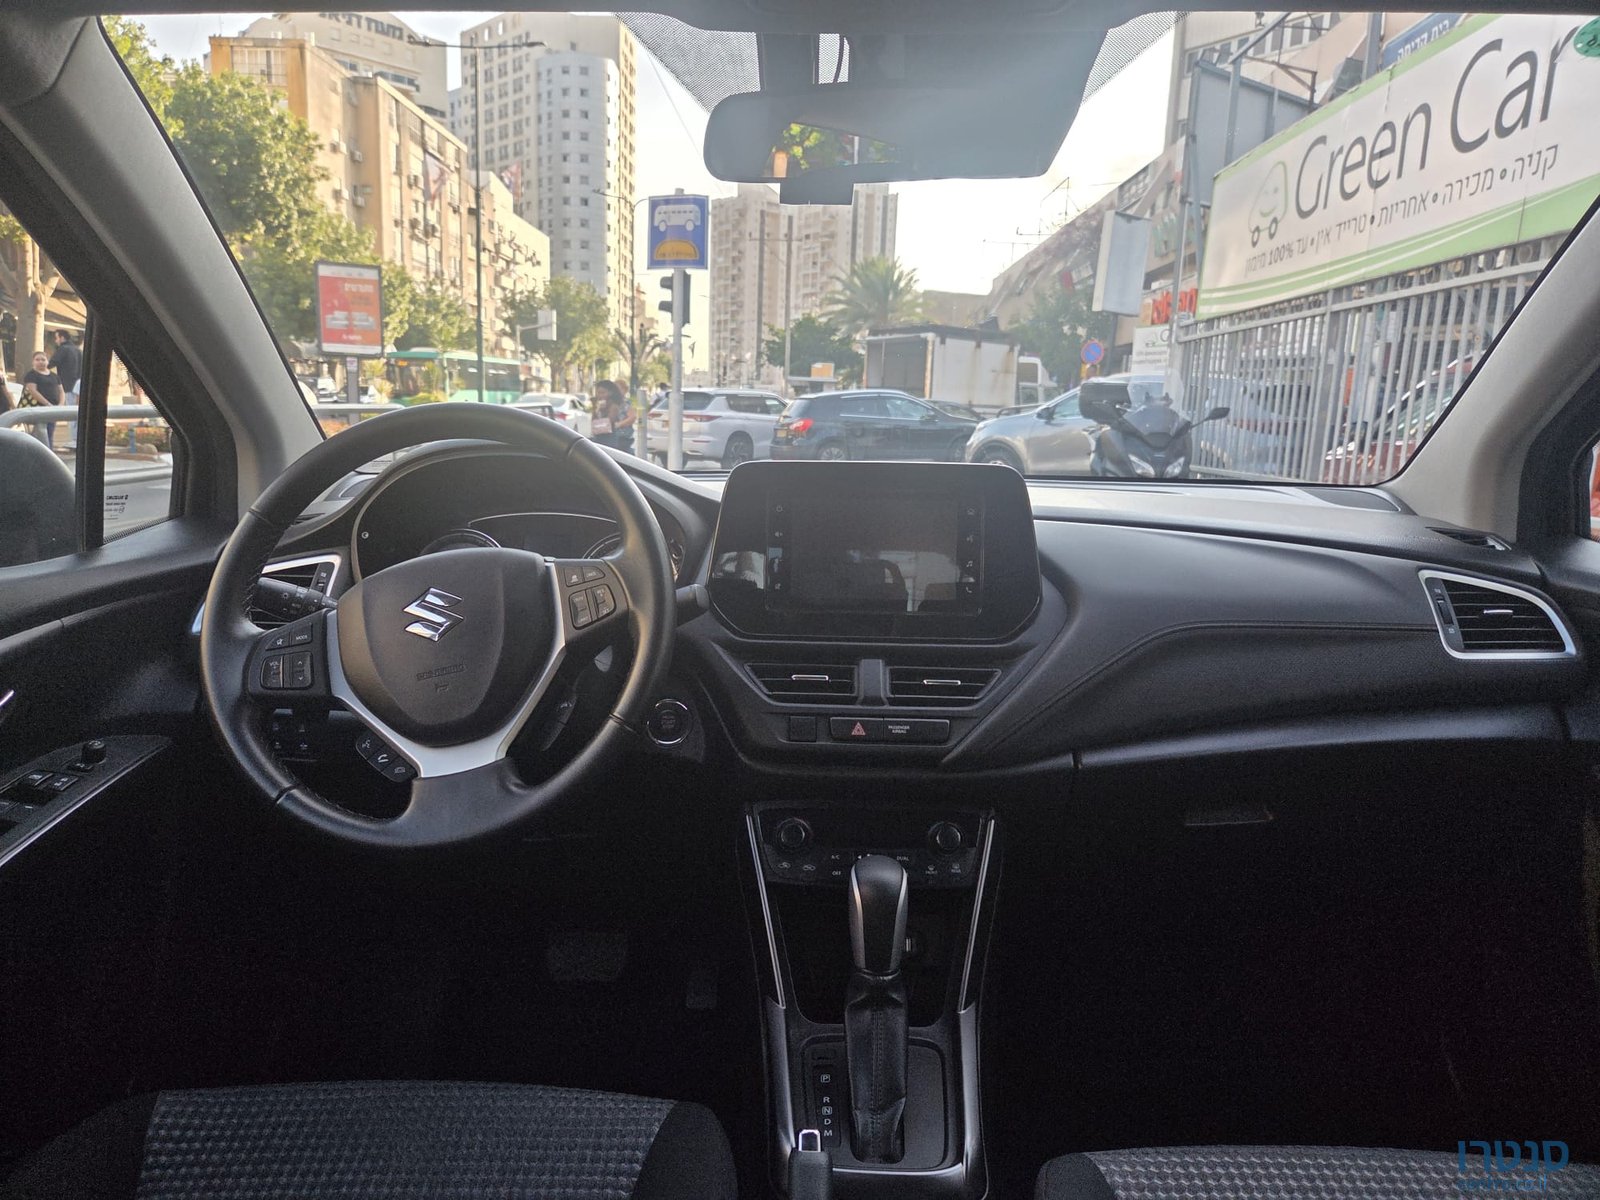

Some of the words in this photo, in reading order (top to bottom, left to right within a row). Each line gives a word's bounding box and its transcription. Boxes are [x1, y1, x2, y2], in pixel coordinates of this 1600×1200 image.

[1295, 102, 1432, 219] Green
[1450, 25, 1580, 154] Car
[1511, 143, 1558, 182] קניה
[1442, 167, 1494, 206] מכירה
[1335, 210, 1367, 239] טרייד
[1376, 190, 1430, 228] אחריות
[1268, 243, 1294, 266] 100%
[1314, 228, 1332, 255] אין
